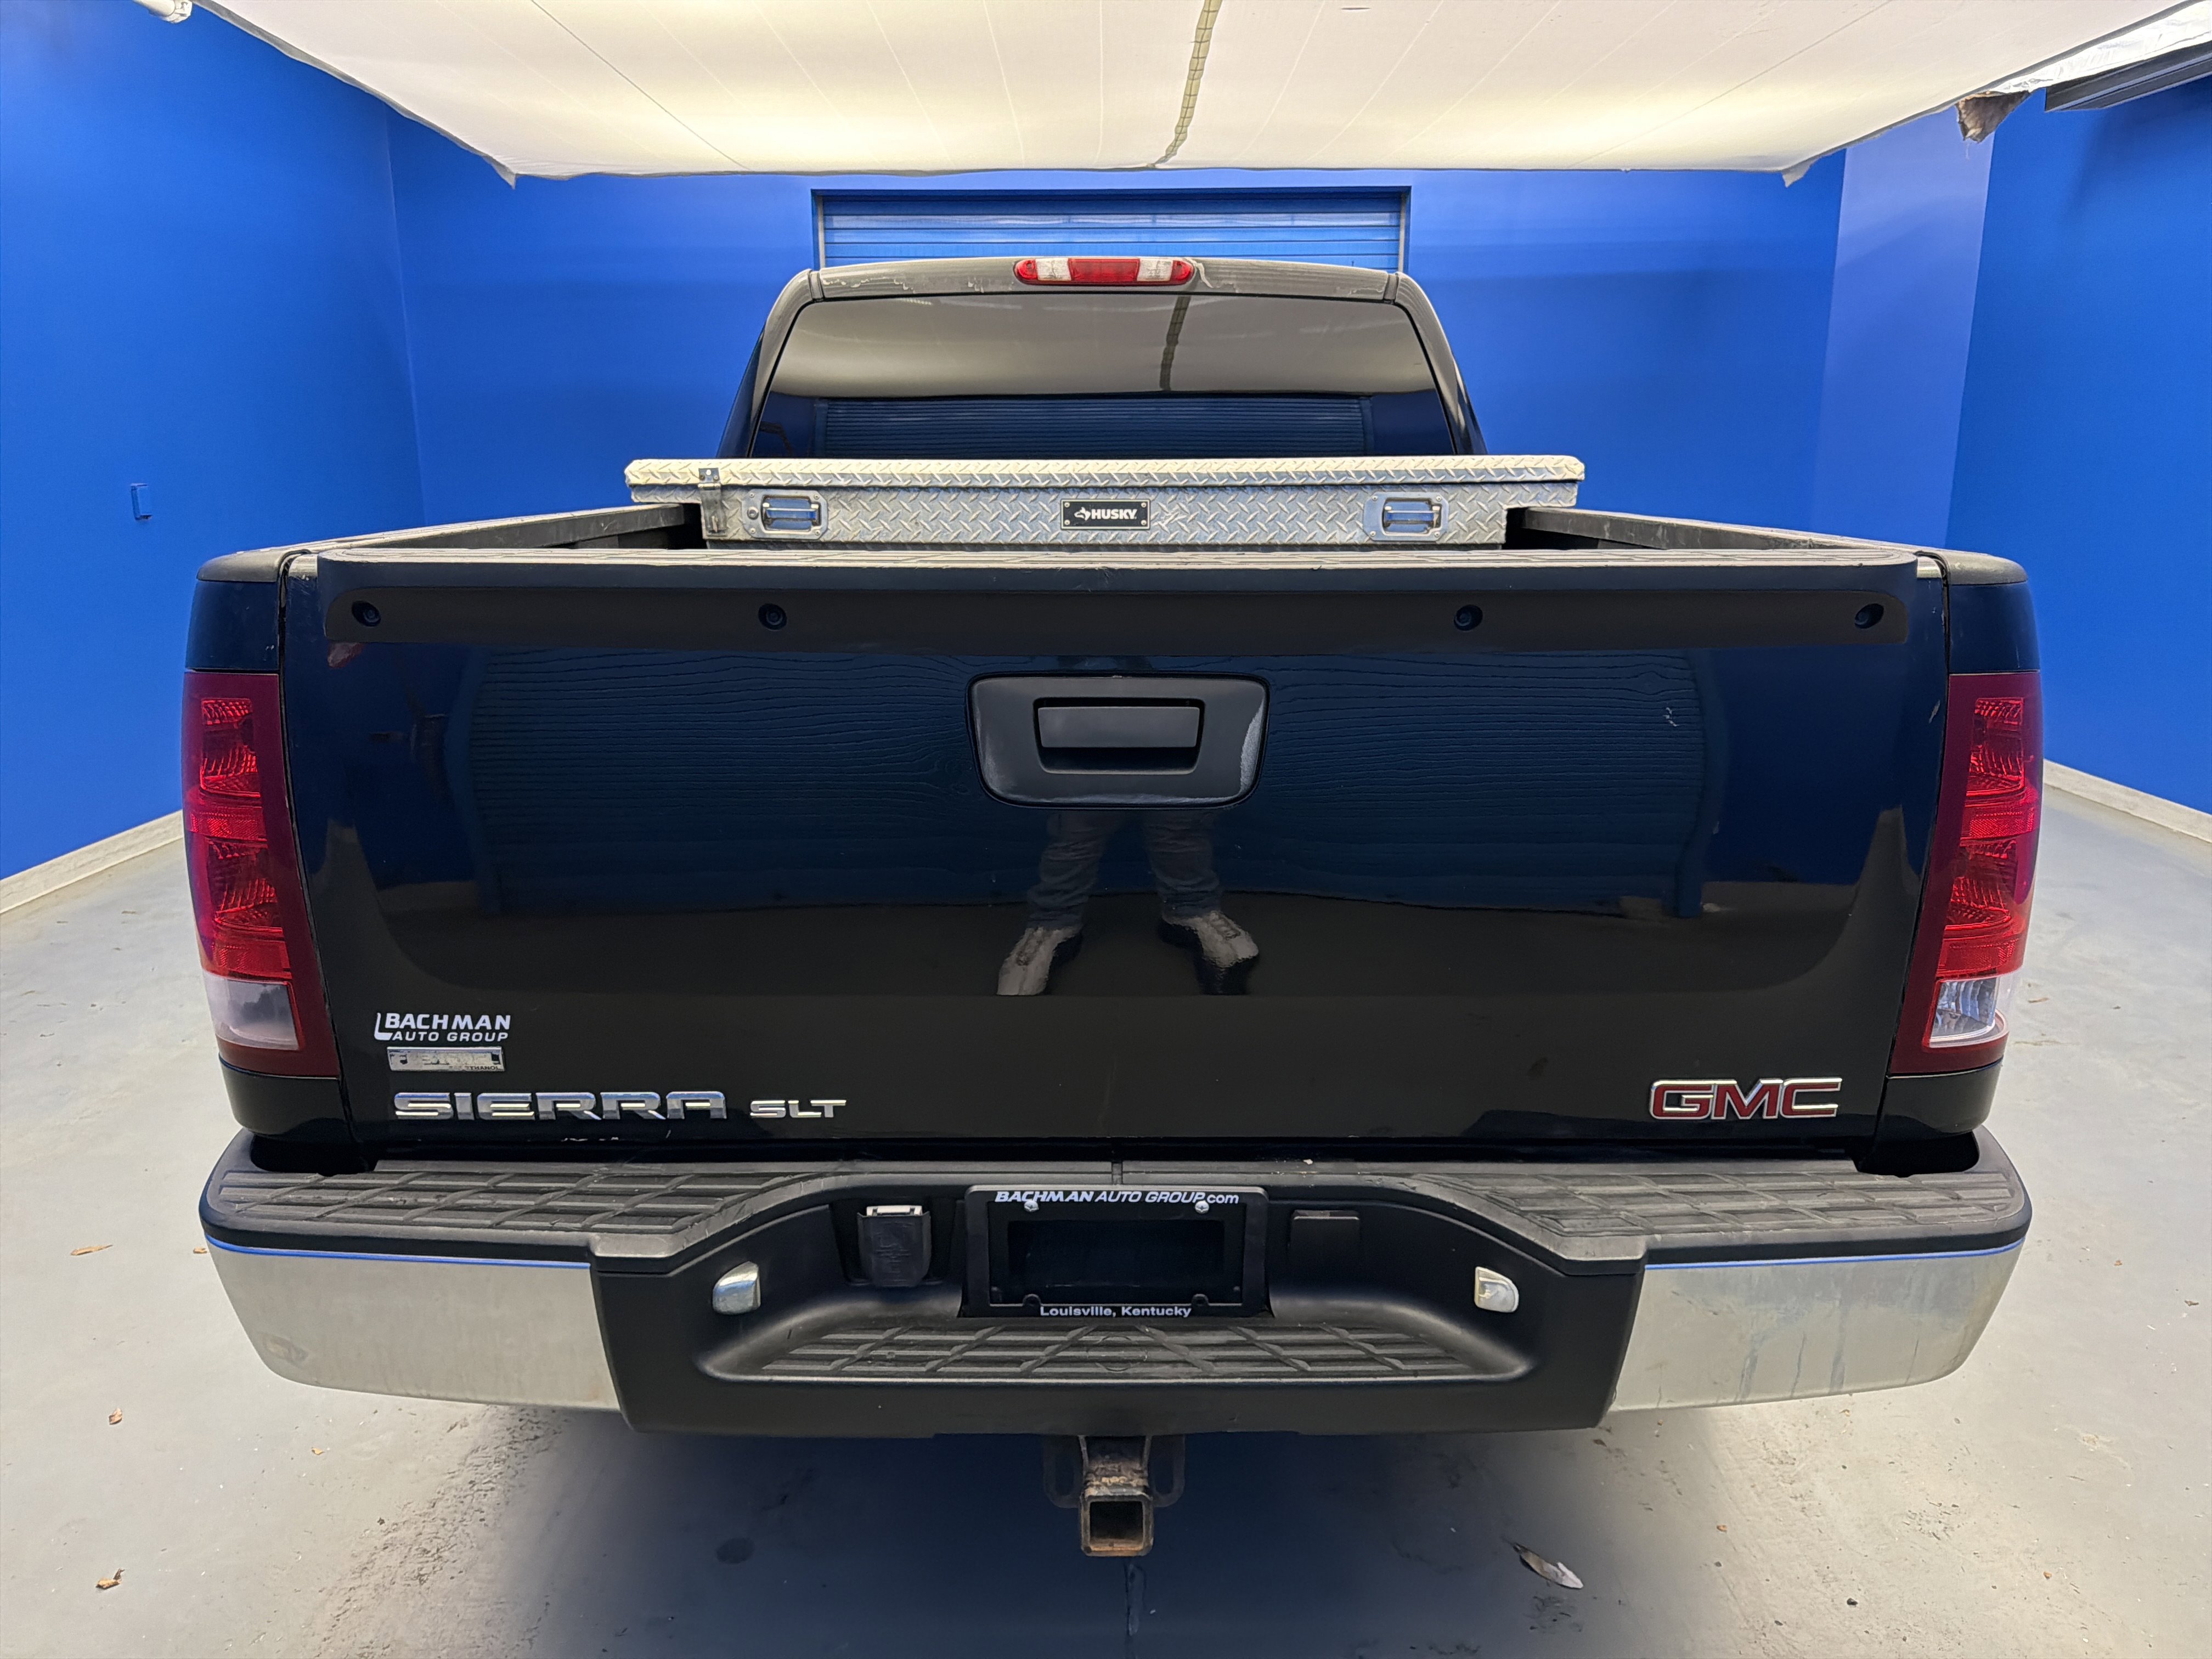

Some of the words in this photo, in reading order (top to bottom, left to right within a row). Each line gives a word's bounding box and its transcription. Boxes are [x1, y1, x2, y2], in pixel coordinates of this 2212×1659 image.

[1091, 509, 1137, 520] HUSKY
[385, 1013, 511, 1030] BACHMAN
[392, 1031, 439, 1041] AUTO
[447, 1032, 509, 1042] GROUP
[1649, 1077, 1843, 1120] GMC
[394, 1091, 727, 1120] SIERRA
[750, 1099, 847, 1119] SLT
[995, 1191, 1094, 1203] BACHMAN
[1094, 1191, 1142, 1203] AUTO
[1040, 1306, 1116, 1317] Louisville,
[1121, 1306, 1192, 1318] Kentucky
